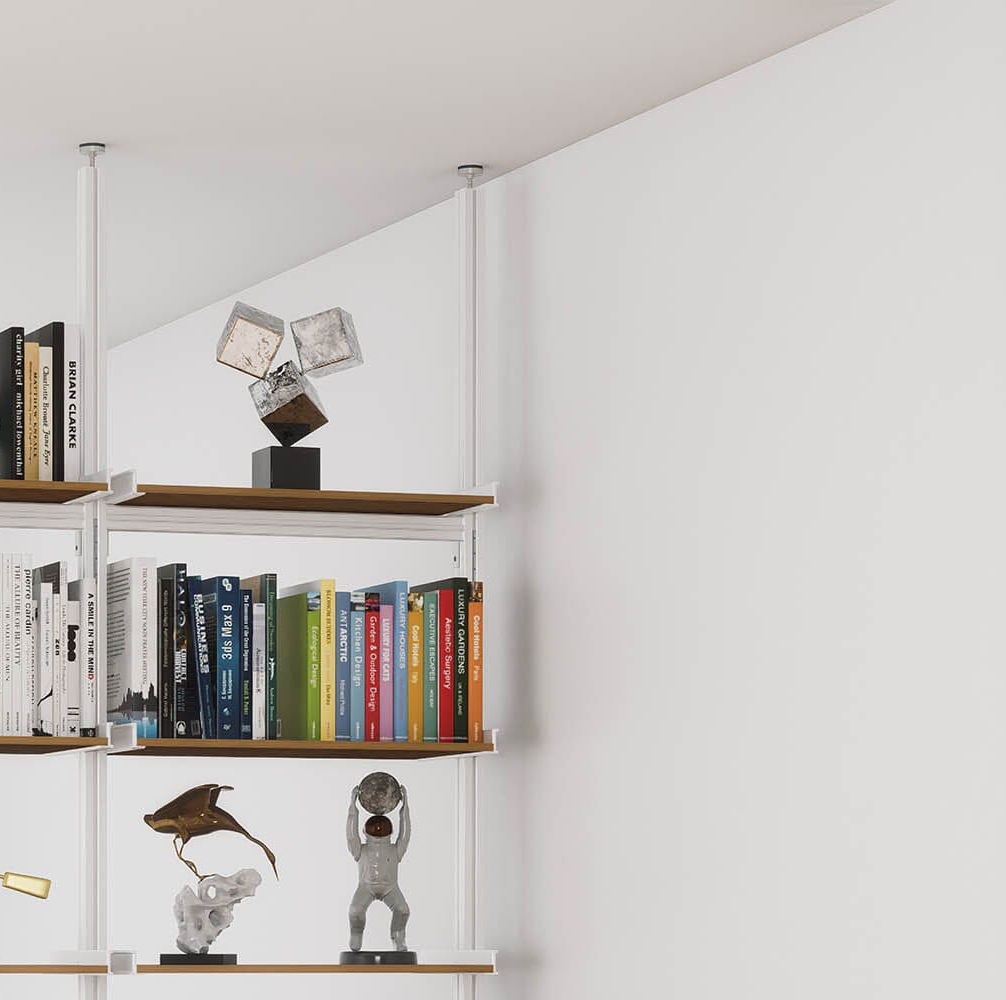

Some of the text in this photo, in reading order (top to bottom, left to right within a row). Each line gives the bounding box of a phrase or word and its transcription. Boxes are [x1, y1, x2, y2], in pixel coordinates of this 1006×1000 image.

[42, 366, 50, 401] Charlotte
[42, 429, 50, 448] Jane
[178, 570, 186, 627] HALO
[88, 628, 94, 638] IN
[198, 594, 210, 674] BUSINESS
[222, 614, 232, 638] Max
[340, 610, 348, 663] ANTARCTIC
[382, 618, 390, 646] LUXURY
[222, 640, 232, 660] 3ds
[354, 655, 362, 687] Design
[382, 663, 390, 682] CATS
[444, 654, 452, 689] Surgery
